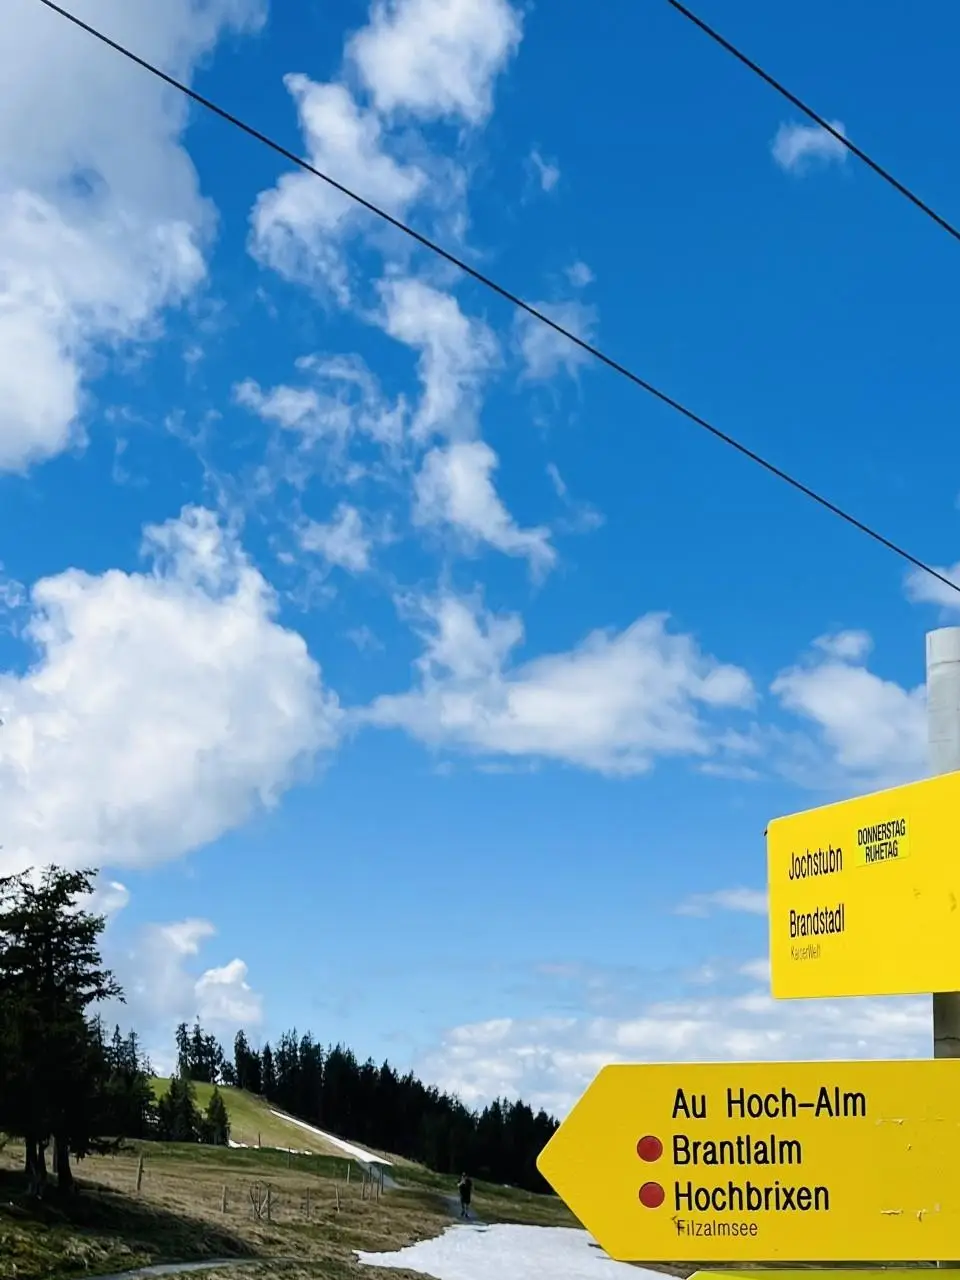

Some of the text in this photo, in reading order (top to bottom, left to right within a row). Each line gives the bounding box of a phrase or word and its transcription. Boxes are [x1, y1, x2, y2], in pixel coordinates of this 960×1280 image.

[857, 818, 906, 845] DONNERSTAG
[788, 845, 843, 880] Jochstubn
[865, 840, 898, 863] RUHETAG
[789, 903, 845, 938] Brandstadl
[672, 1087, 866, 1118] Au Hoch-Alm
[673, 1134, 802, 1164] Brantlalm
[675, 1181, 829, 1211] Hochbrixen
[677, 1219, 758, 1236] Filzalmsee
